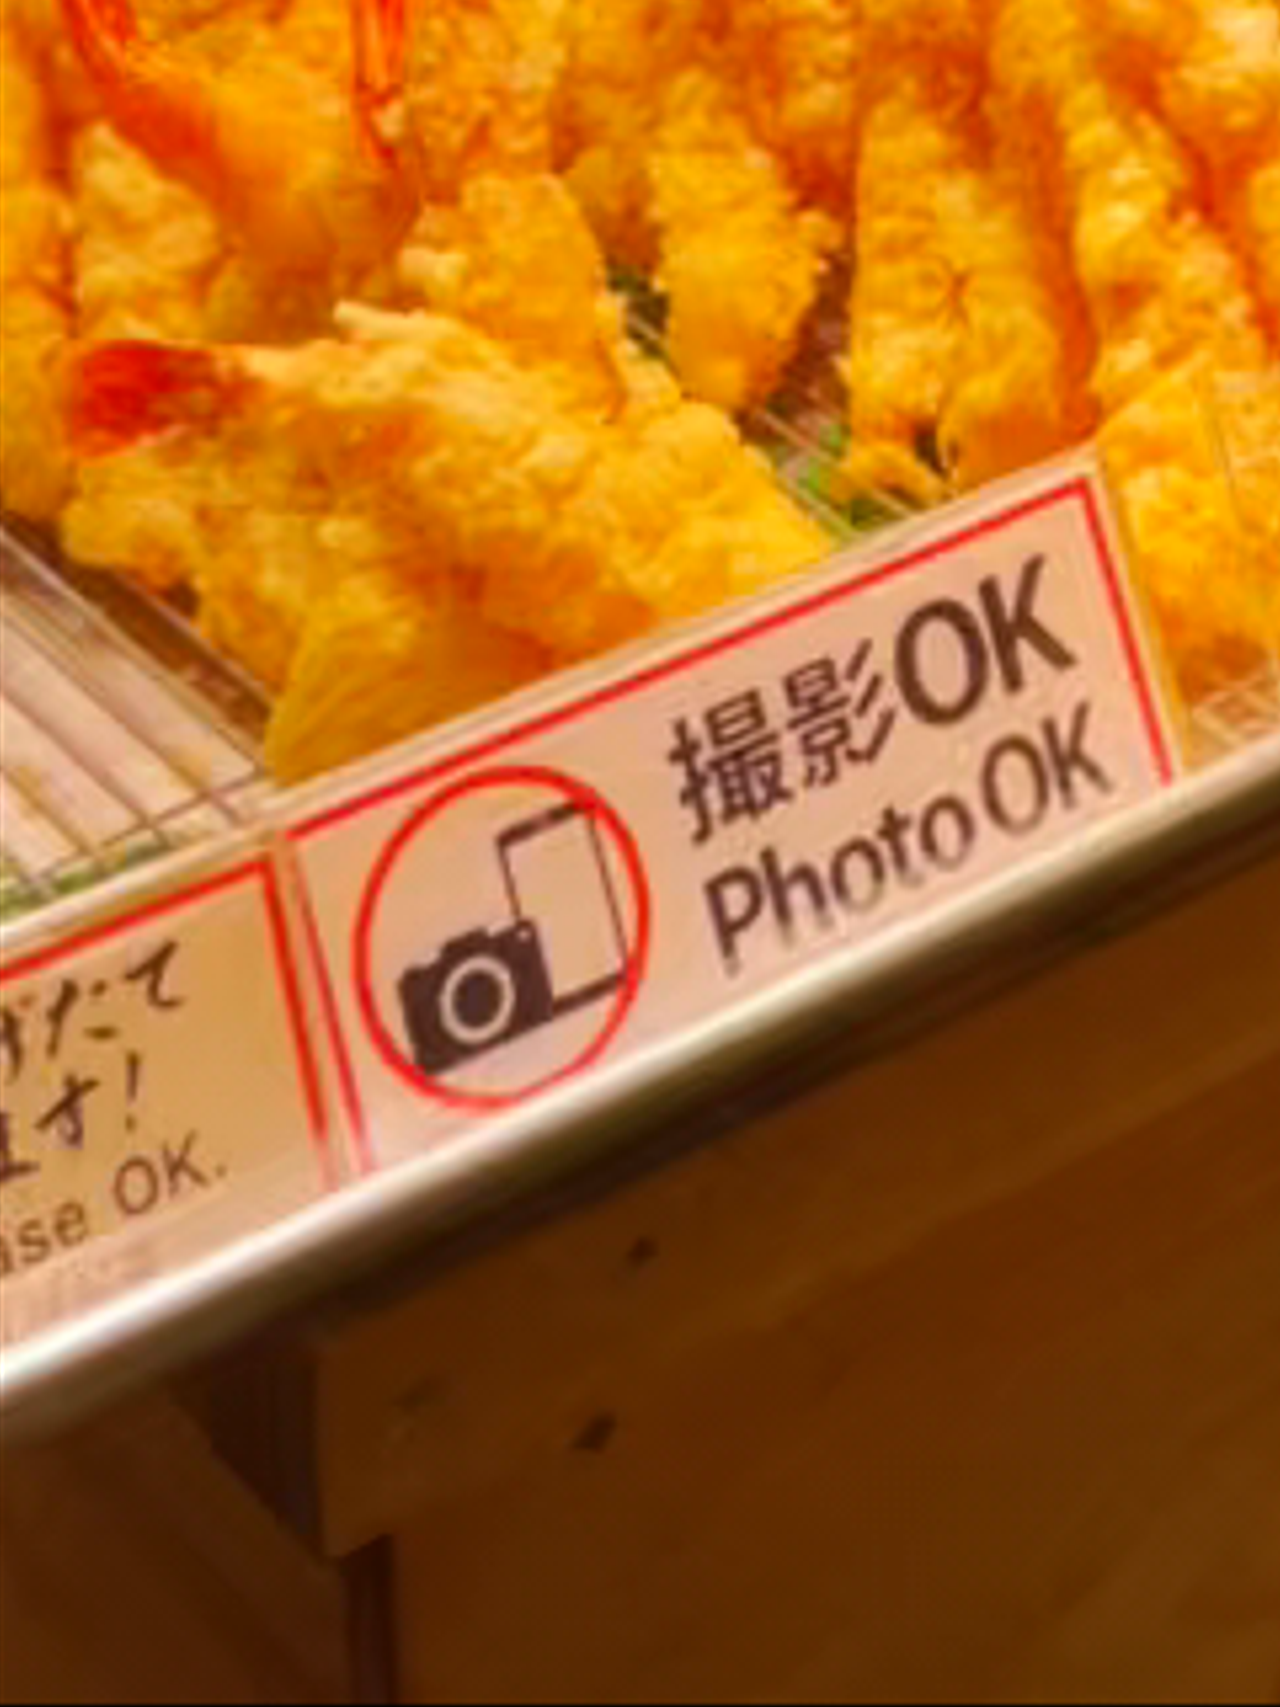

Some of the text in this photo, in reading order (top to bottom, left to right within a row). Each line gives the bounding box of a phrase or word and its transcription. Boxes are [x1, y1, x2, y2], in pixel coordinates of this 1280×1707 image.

[666, 553, 1078, 847] 撮影OK
[704, 700, 1113, 974] Photo OK
[113, 1127, 227, 1216] OK.
